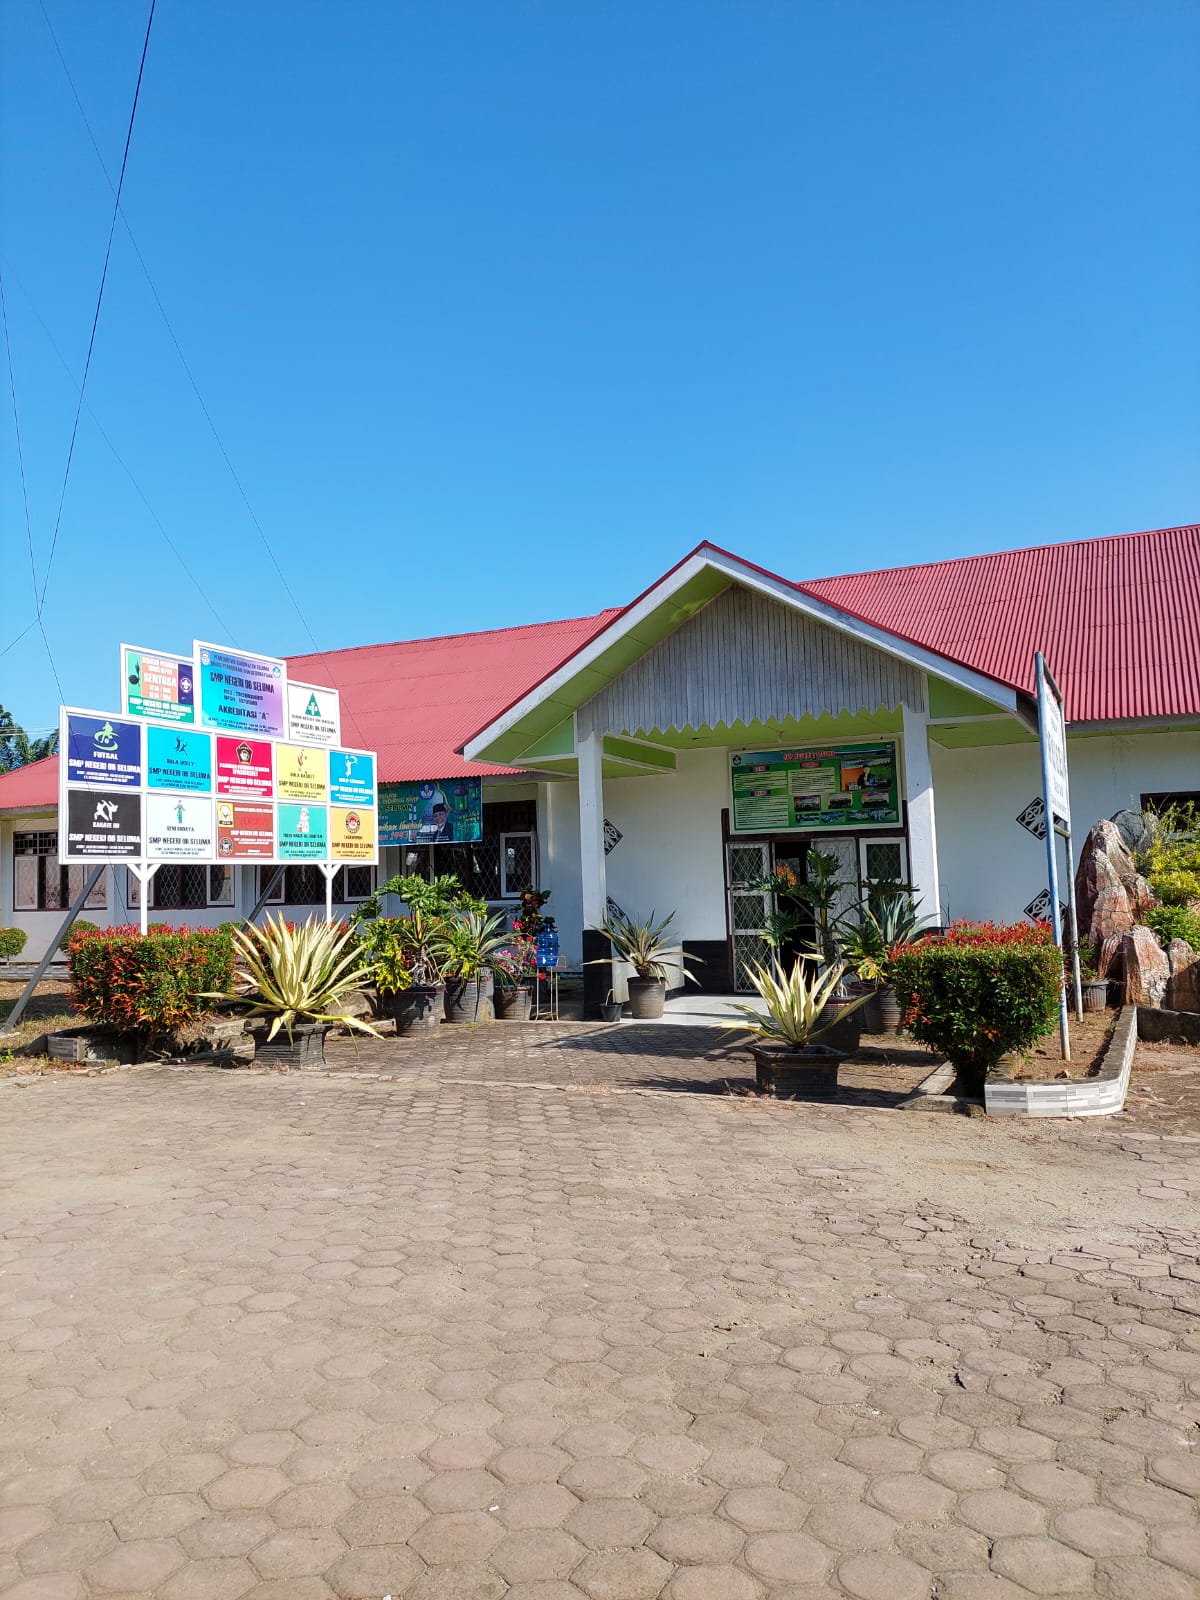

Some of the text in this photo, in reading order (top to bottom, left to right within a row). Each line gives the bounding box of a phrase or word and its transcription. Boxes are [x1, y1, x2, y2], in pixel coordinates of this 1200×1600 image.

[210, 671, 275, 694] SMP NEGERI 06 SELUMA
[218, 704, 257, 718] AKREDITASI
[93, 751, 119, 760] FUTSAL
